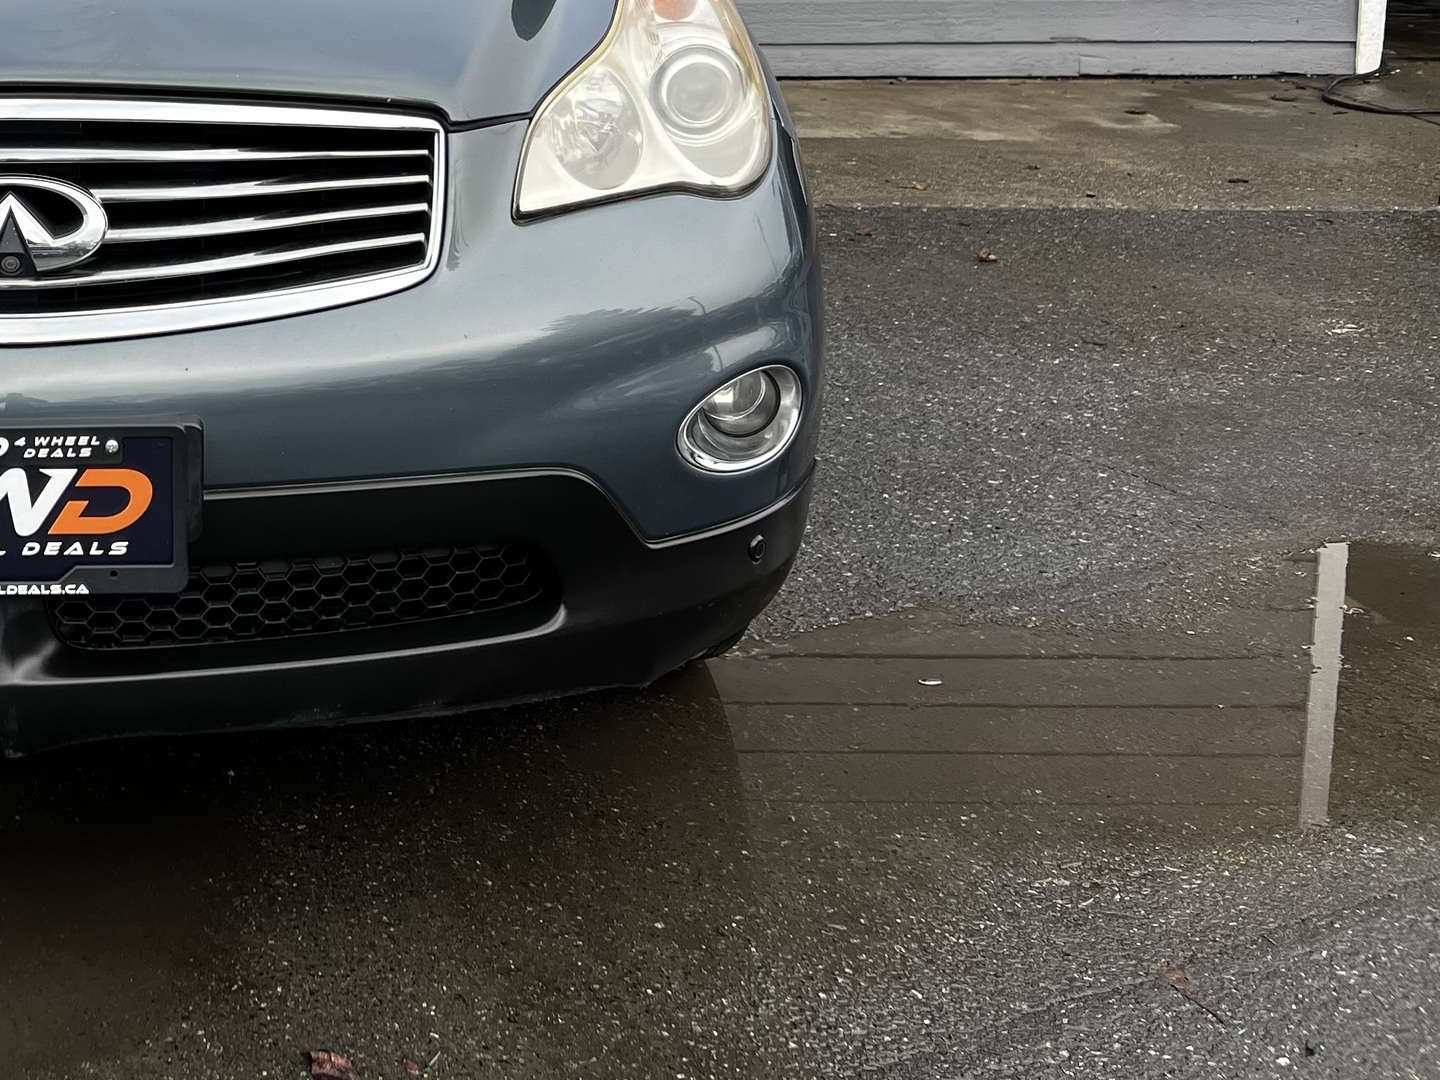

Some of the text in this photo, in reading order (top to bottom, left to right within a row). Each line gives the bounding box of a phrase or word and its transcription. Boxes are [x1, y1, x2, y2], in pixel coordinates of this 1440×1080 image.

[14, 435, 100, 447] 4 WHEEL
[23, 447, 92, 458] DEALS
[22, 541, 129, 556] DEALS
